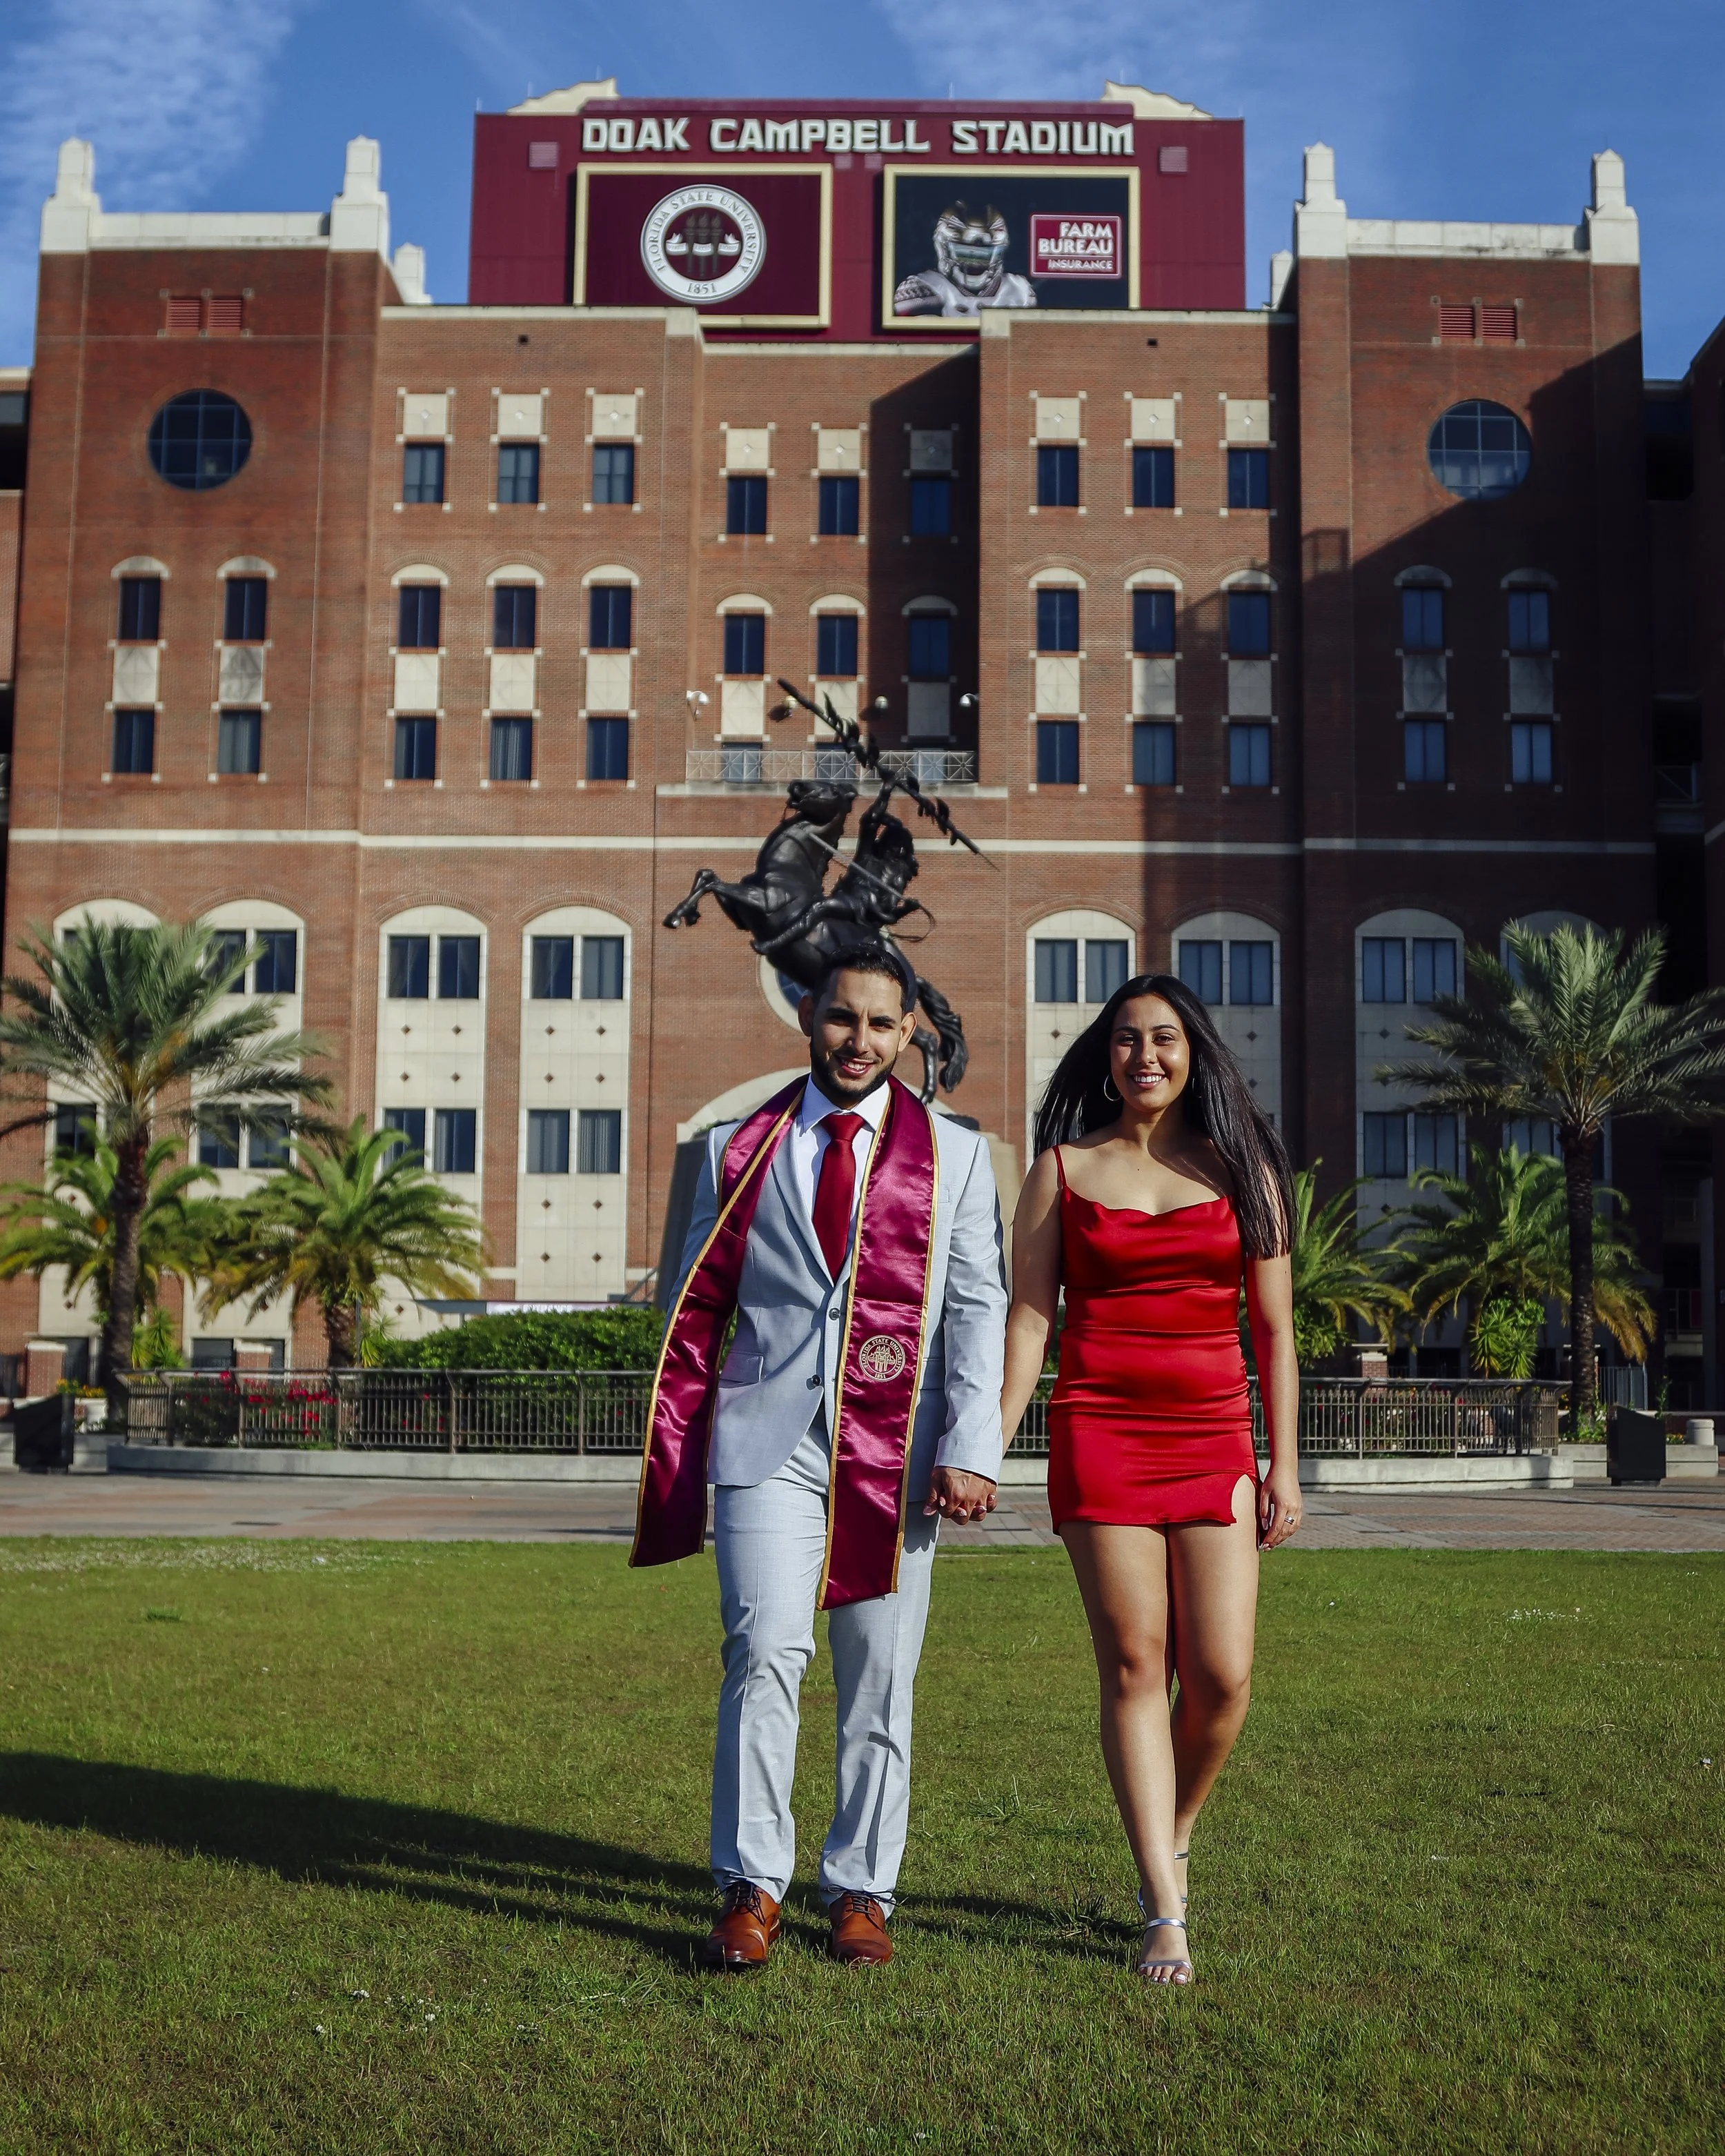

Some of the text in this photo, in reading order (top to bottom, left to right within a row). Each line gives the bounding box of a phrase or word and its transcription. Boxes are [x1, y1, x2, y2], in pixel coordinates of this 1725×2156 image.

[582, 117, 1136, 155] DOAK CAMPBELL STADIUM
[649, 190, 757, 273] FLORIDA STATE UNIVERSITY
[1060, 221, 1113, 237] FARM
[1038, 238, 1113, 254] BUREAU
[1048, 259, 1113, 270] INSURANCE
[687, 283, 717, 294] 1851
[862, 1344, 871, 1368] FLORIDA
[890, 1341, 902, 1373] UNIVERSITY
